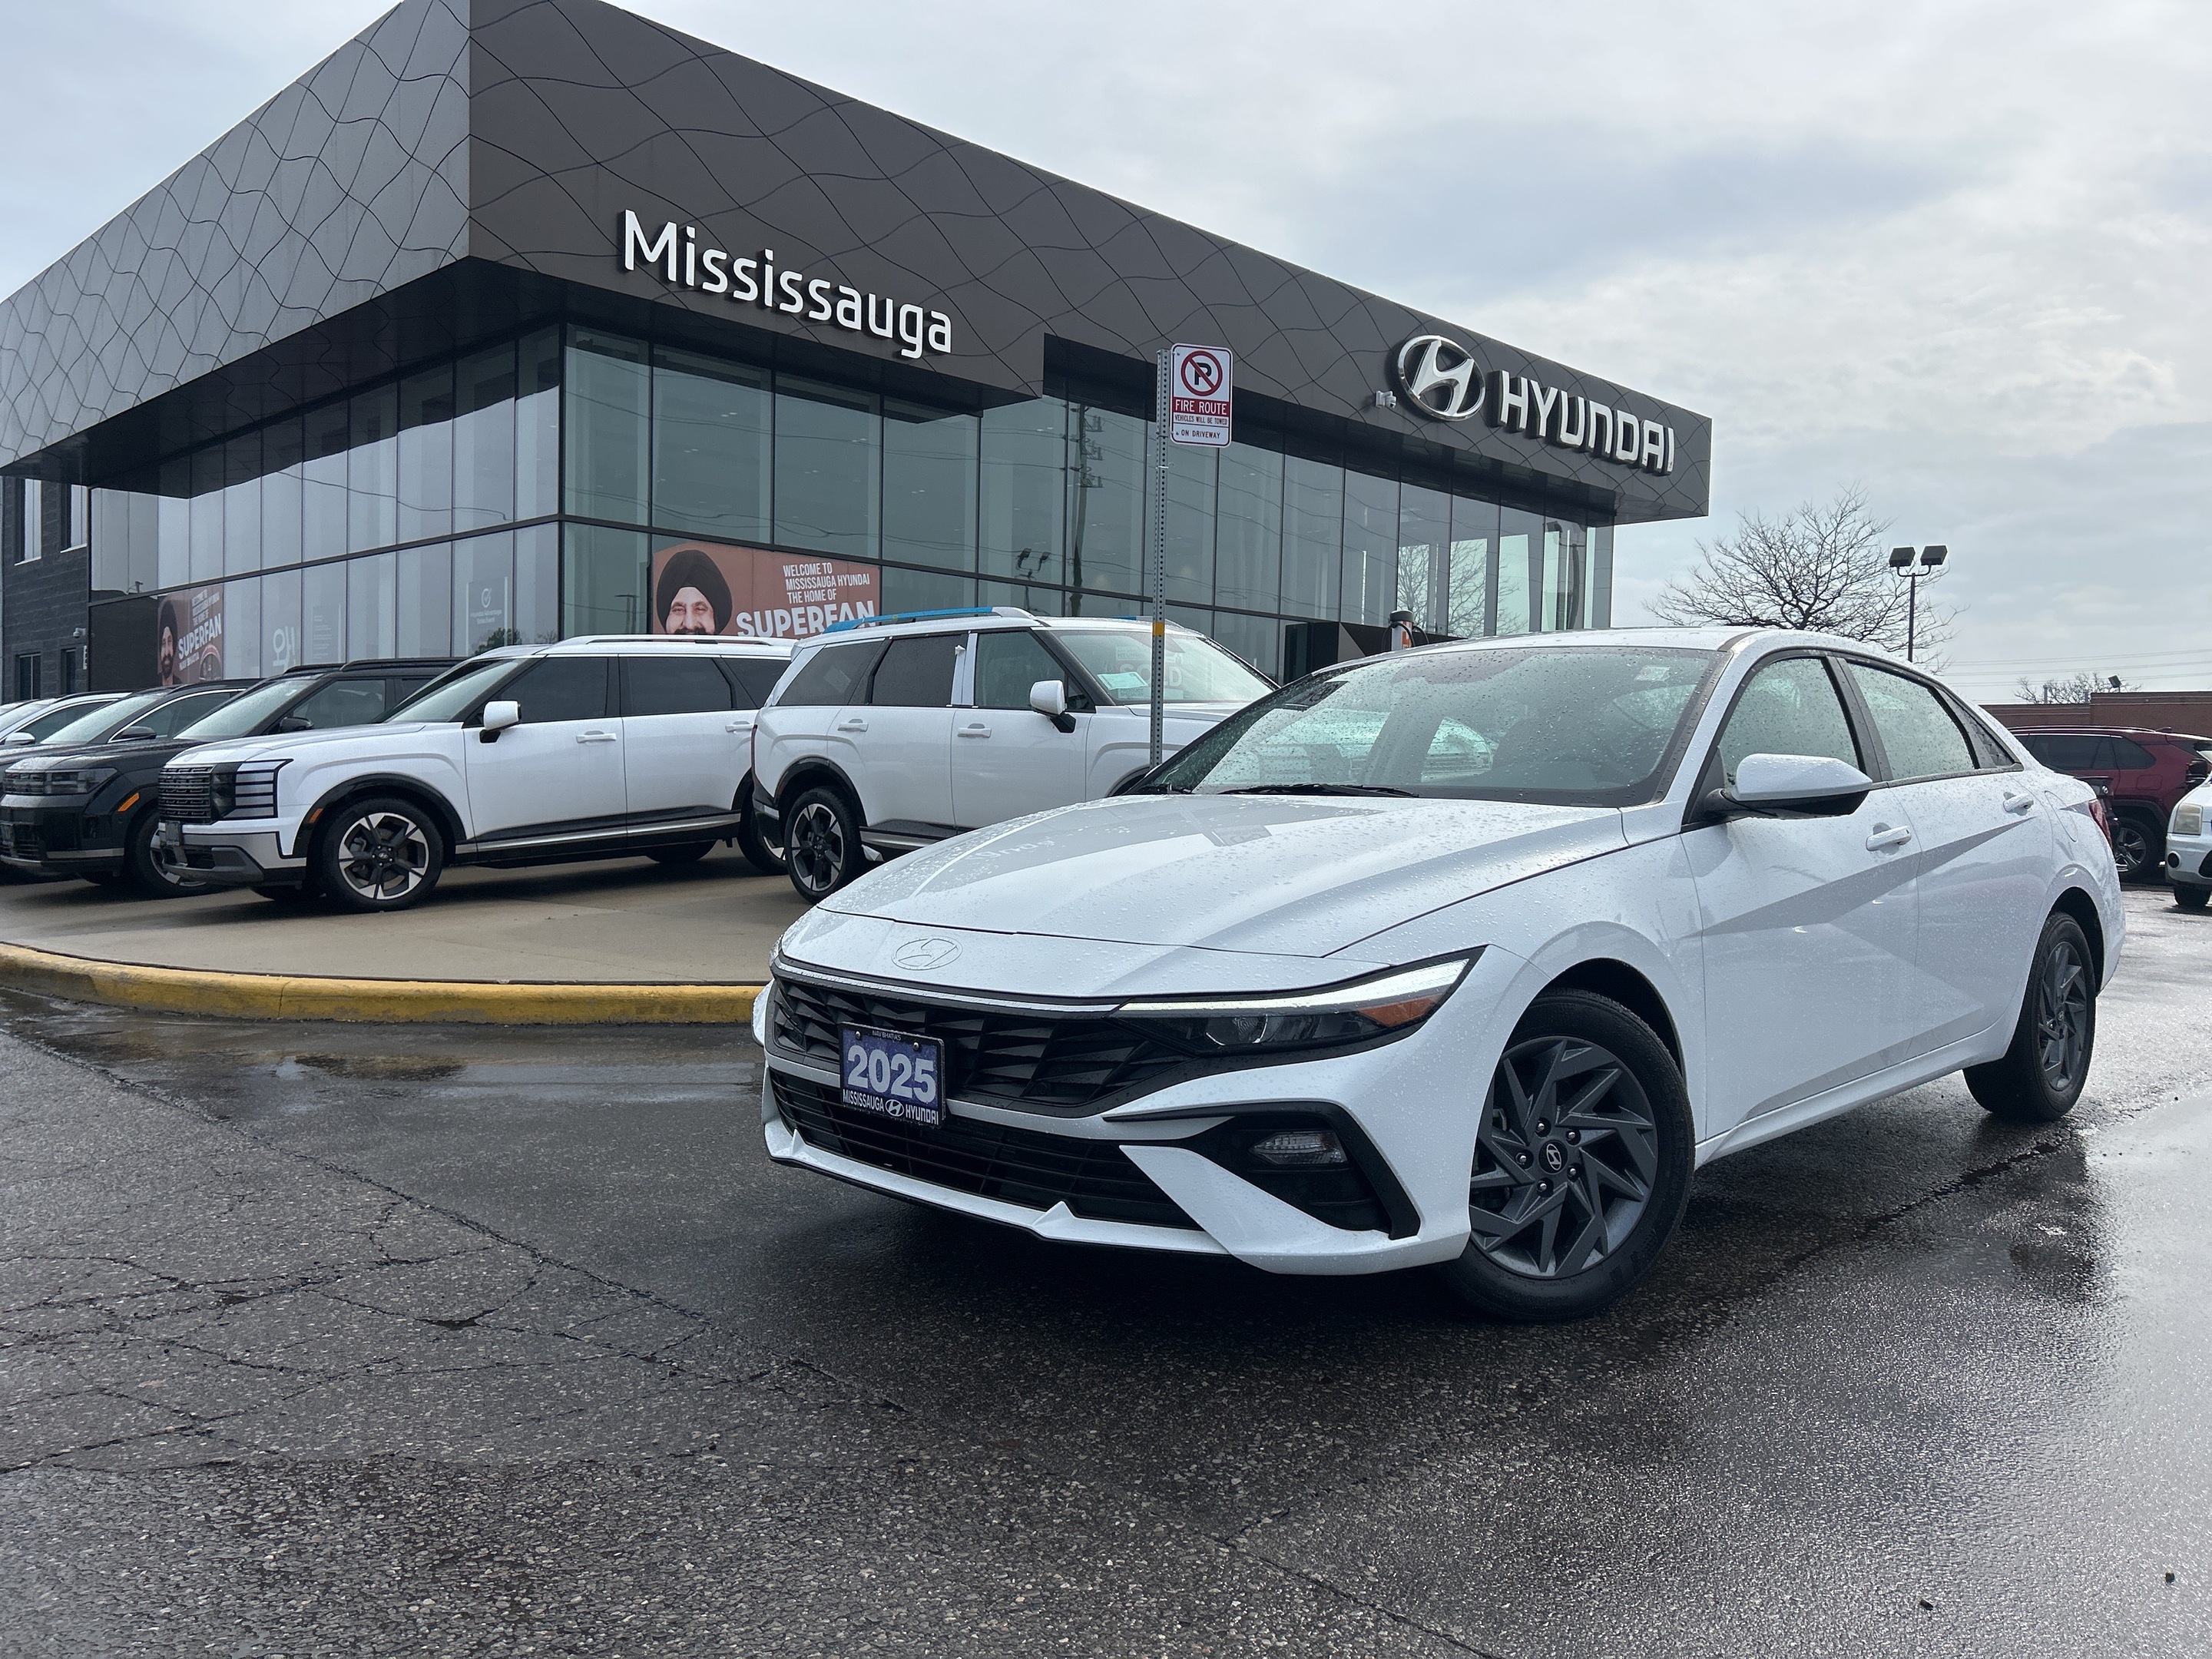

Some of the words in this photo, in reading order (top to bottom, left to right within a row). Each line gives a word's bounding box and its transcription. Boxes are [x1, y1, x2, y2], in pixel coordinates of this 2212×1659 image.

[624, 209, 952, 359] Mississauga
[1175, 399, 1195, 412] FIRE
[1199, 402, 1227, 415] ROUTE
[1498, 370, 1676, 475] HYUNDAI
[1192, 430, 1220, 439] DRIVEWAY
[783, 563, 822, 577] WELCOME
[822, 562, 833, 575] TO
[786, 575, 836, 591] MISSISSAUGA
[836, 574, 870, 586] HYUNDAI
[787, 592, 803, 604] THE
[803, 590, 826, 602] HOME
[826, 588, 837, 600] OF
[178, 613, 222, 660] SUPERFAN
[736, 601, 876, 637] SUPERFAN
[848, 1045, 936, 1104] 2025
[843, 1089, 885, 1112] MISSISSAUGA
[906, 1104, 939, 1125] HYUNDAI
